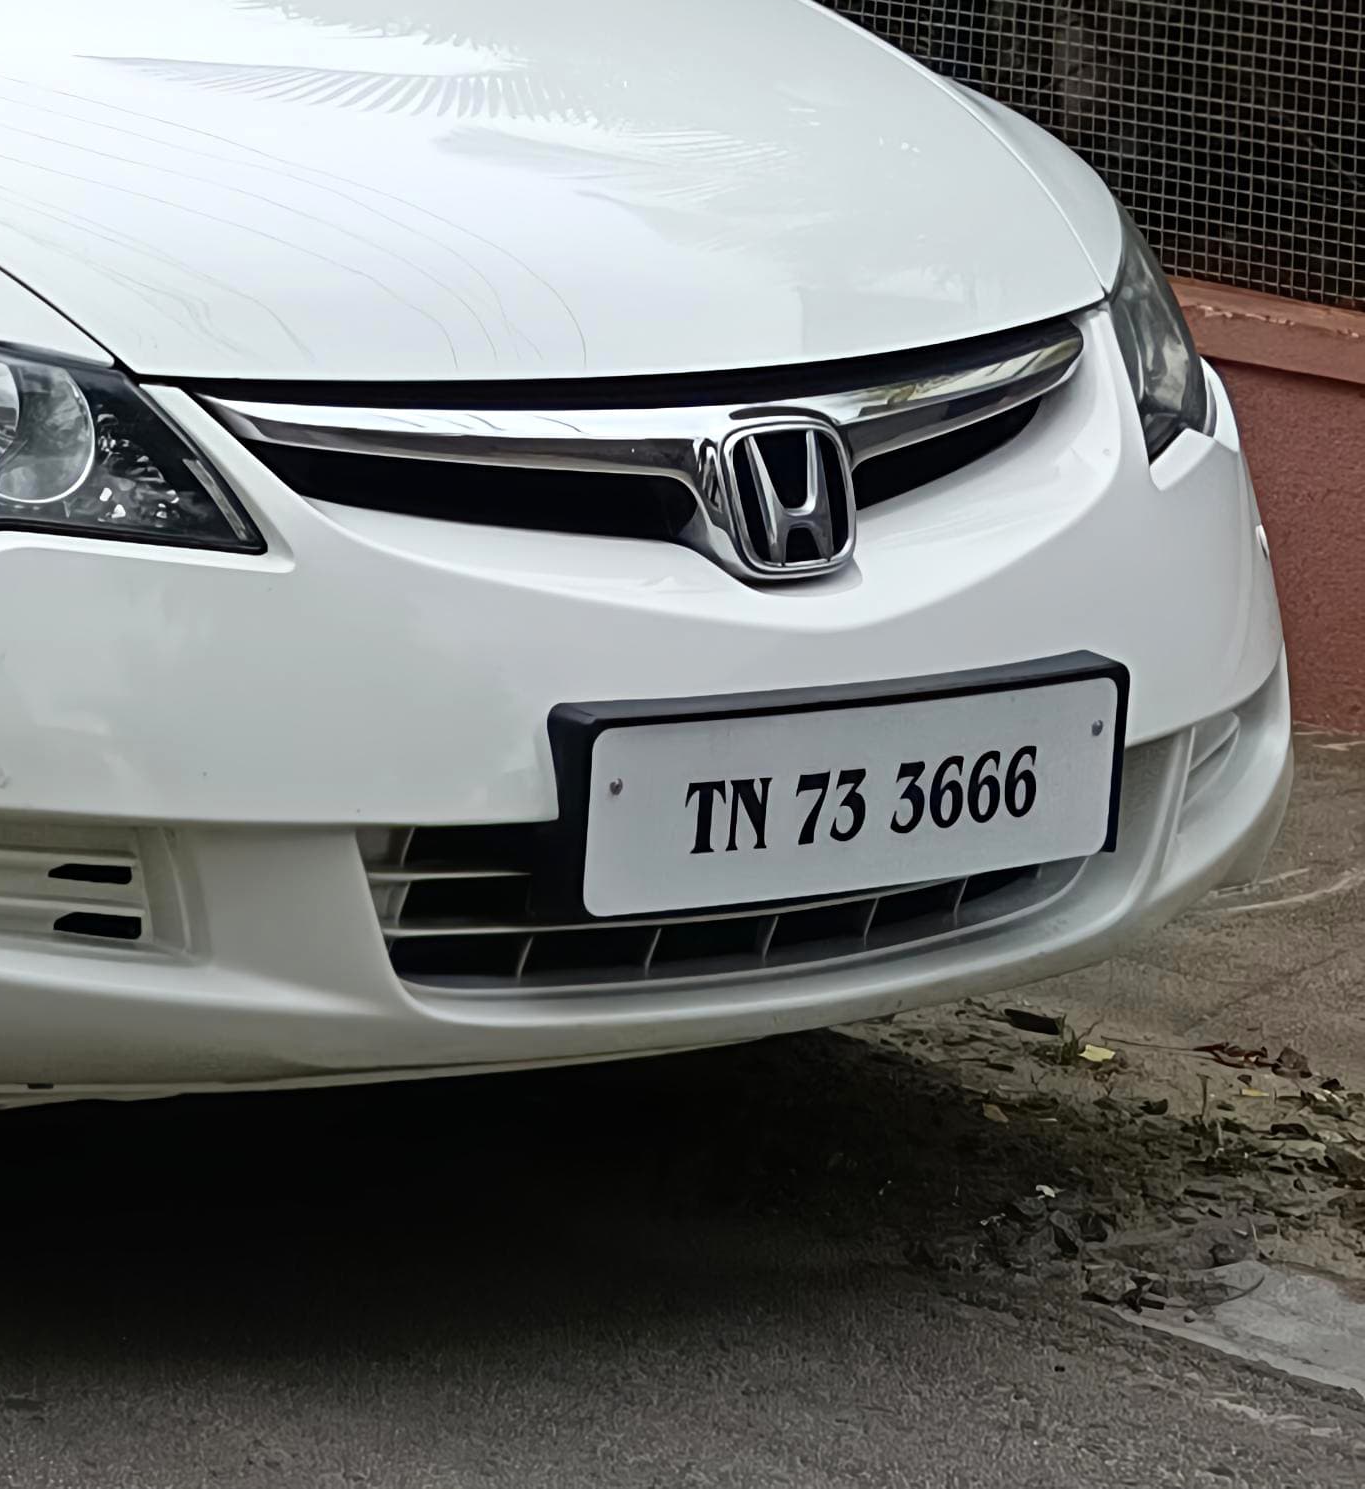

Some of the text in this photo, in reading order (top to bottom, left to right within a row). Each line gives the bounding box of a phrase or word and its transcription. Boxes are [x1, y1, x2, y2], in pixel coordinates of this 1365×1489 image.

[684, 745, 1038, 855] TN 73 3666
